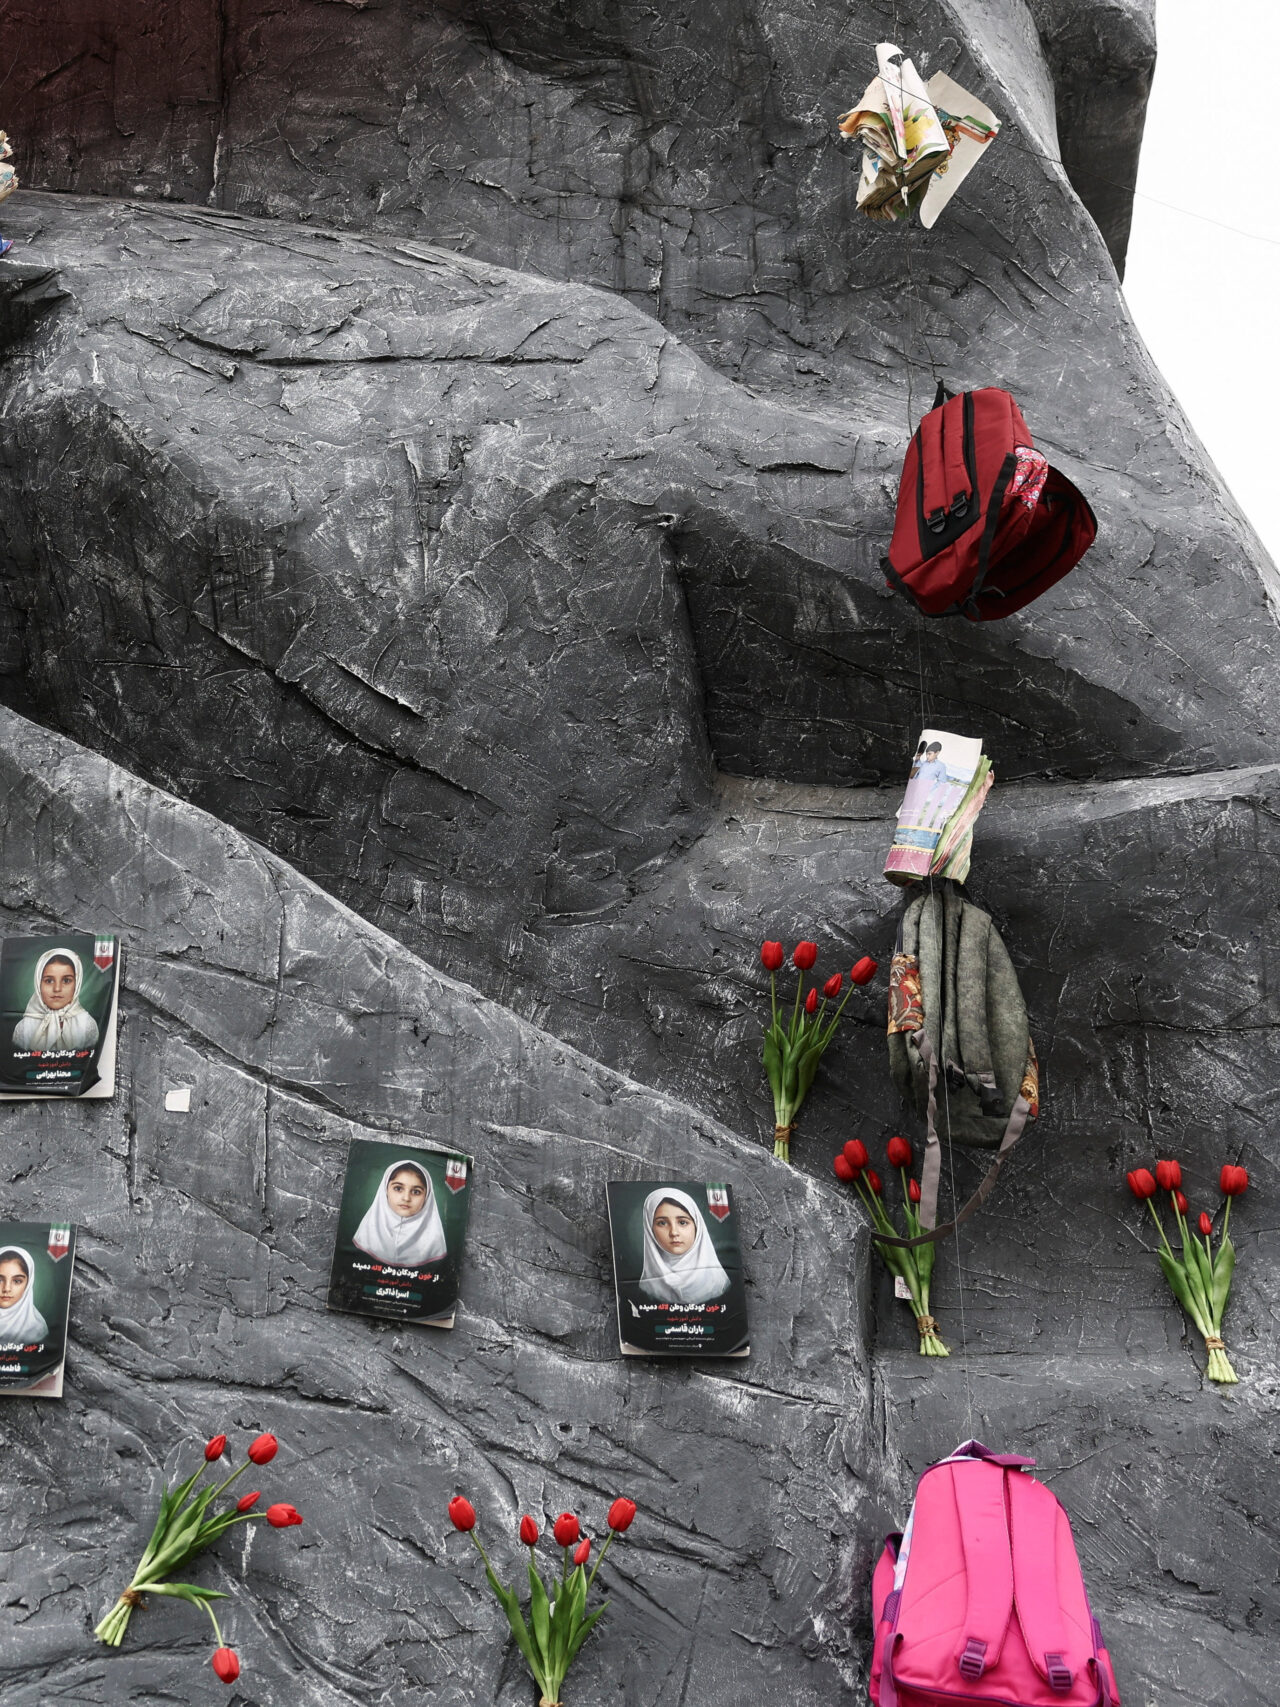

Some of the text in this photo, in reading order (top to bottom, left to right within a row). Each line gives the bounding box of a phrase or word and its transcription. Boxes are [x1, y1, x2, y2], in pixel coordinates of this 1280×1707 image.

[13, 1050, 31, 1059] دمیده
[41, 1049, 55, 1058] وطن
[55, 1049, 76, 1058] کودکان
[75, 1050, 89, 1058] خون
[36, 1070, 56, 1080] بهرامی
[352, 1262, 371, 1271] دمیده
[371, 1264, 383, 1272] لاله
[382, 1266, 396, 1275] وطن
[396, 1268, 419, 1278] کودکان
[418, 1272, 432, 1280] خون
[375, 1287, 410, 1299] اسرا ذاکری
[639, 1304, 658, 1312] دمیده
[669, 1303, 684, 1312] وطن
[684, 1303, 706, 1312] کودکان
[664, 1323, 688, 1335] قاسمی
[2, 1342, 24, 1352] کودکان
[24, 1344, 38, 1352] خون
[1, 1362, 21, 1372] فاطمه
